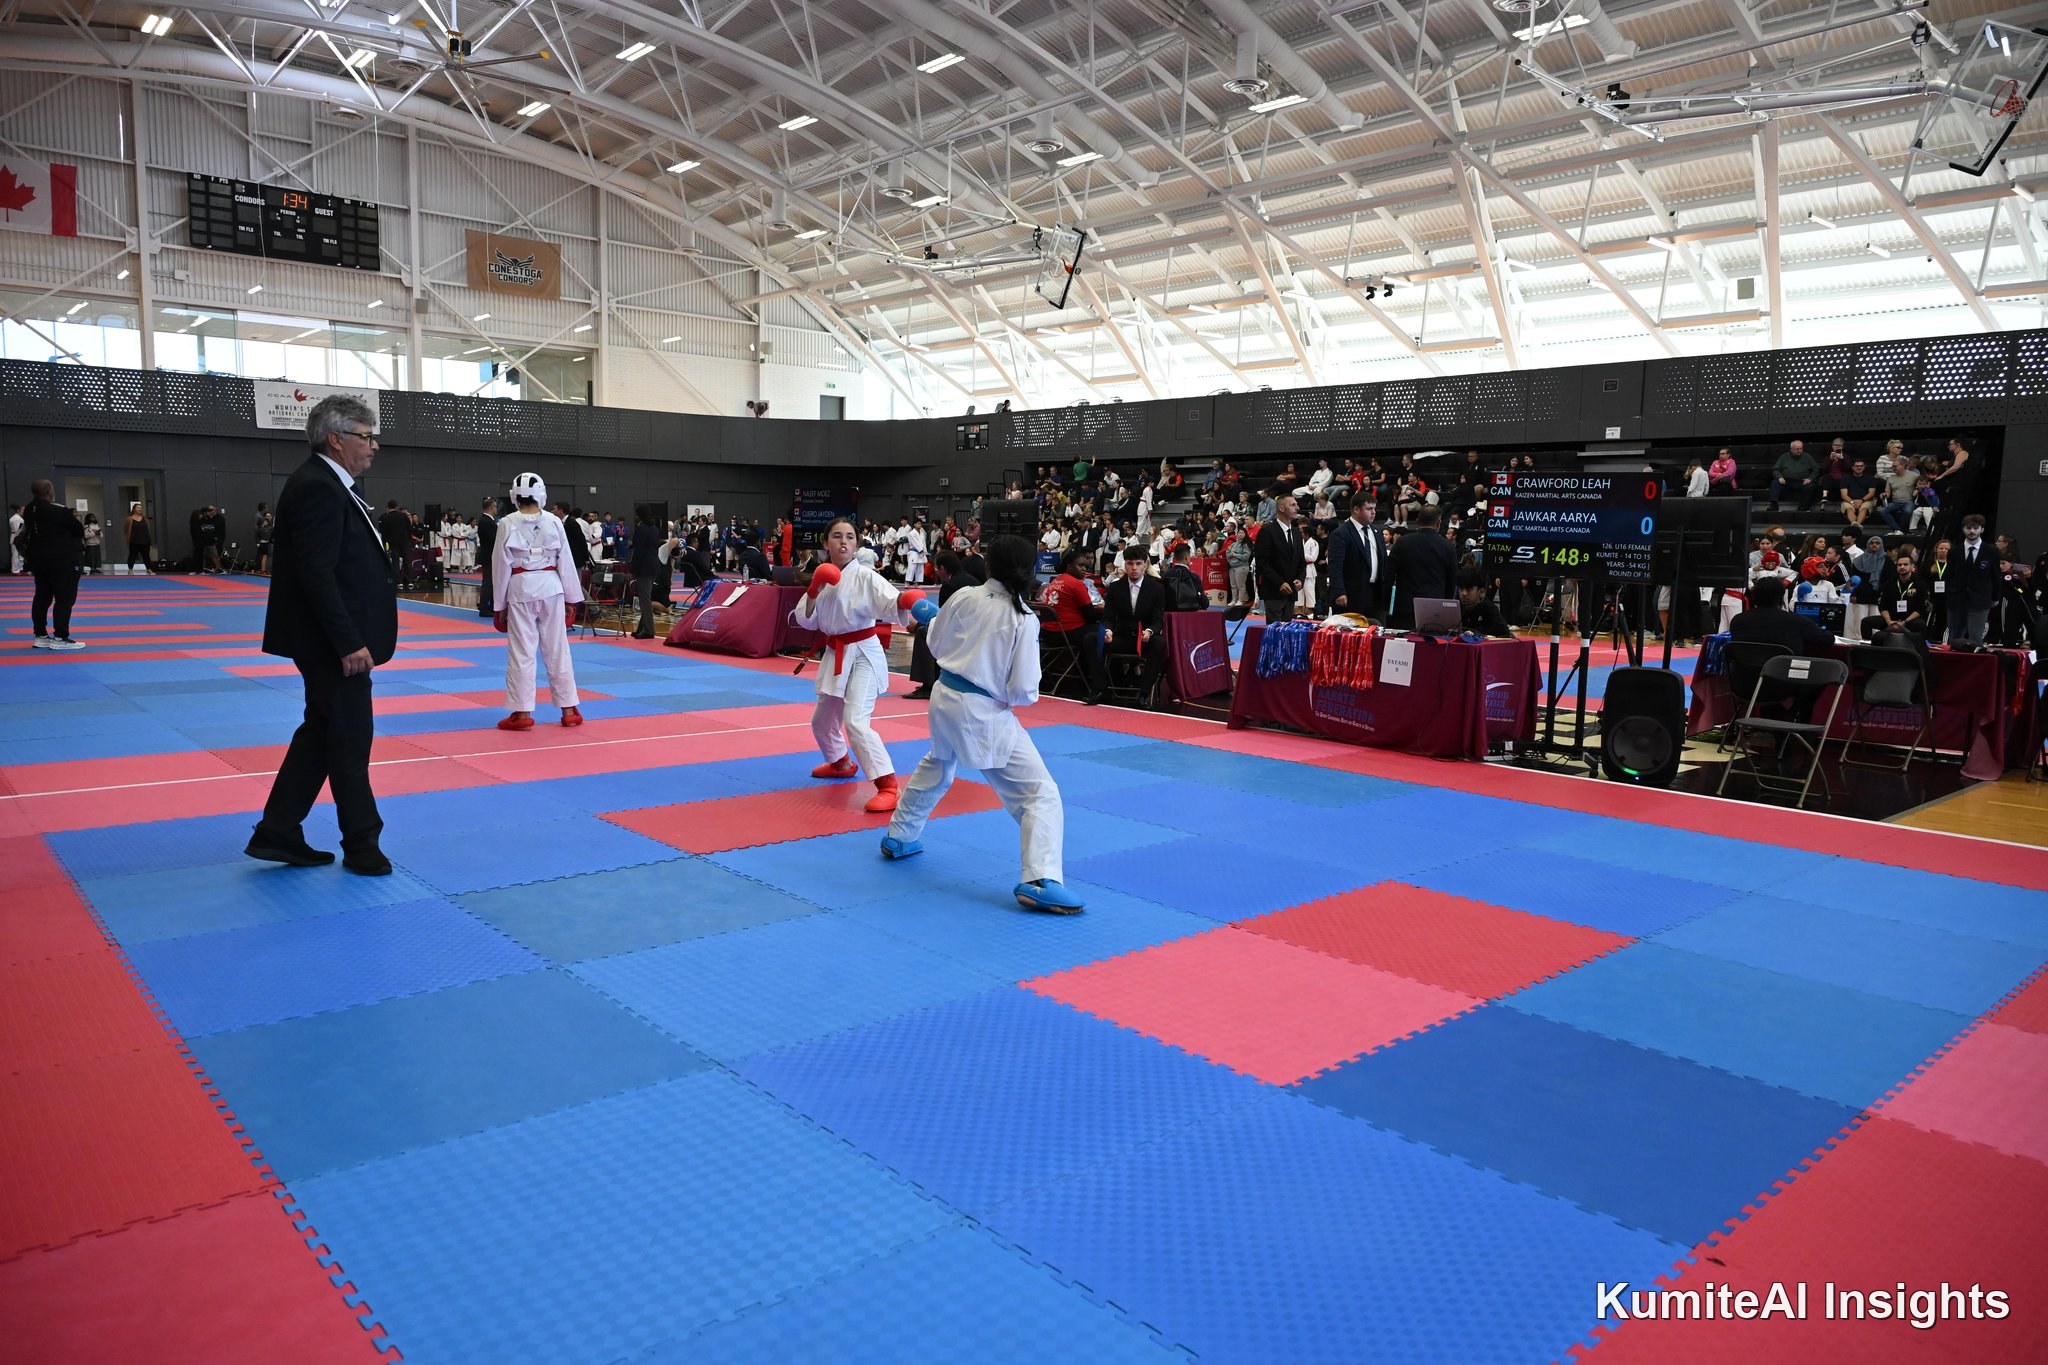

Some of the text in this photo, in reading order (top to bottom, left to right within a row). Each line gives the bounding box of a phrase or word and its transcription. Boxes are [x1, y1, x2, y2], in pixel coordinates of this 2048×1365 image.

[234, 194, 266, 206] CONDORS
[283, 192, 308, 209] 1:34
[314, 208, 334, 216] GUEST
[488, 263, 542, 280] CONESTOGA
[498, 274, 534, 286] CONDORS
[1490, 486, 1512, 496] CAN
[1516, 478, 1657, 500] CRAWFORD LEAH 0
[1488, 519, 1508, 528] CAN
[1513, 511, 1654, 535] JAWKAR AARYA 0
[1387, 658, 1409, 667] TATAMI
